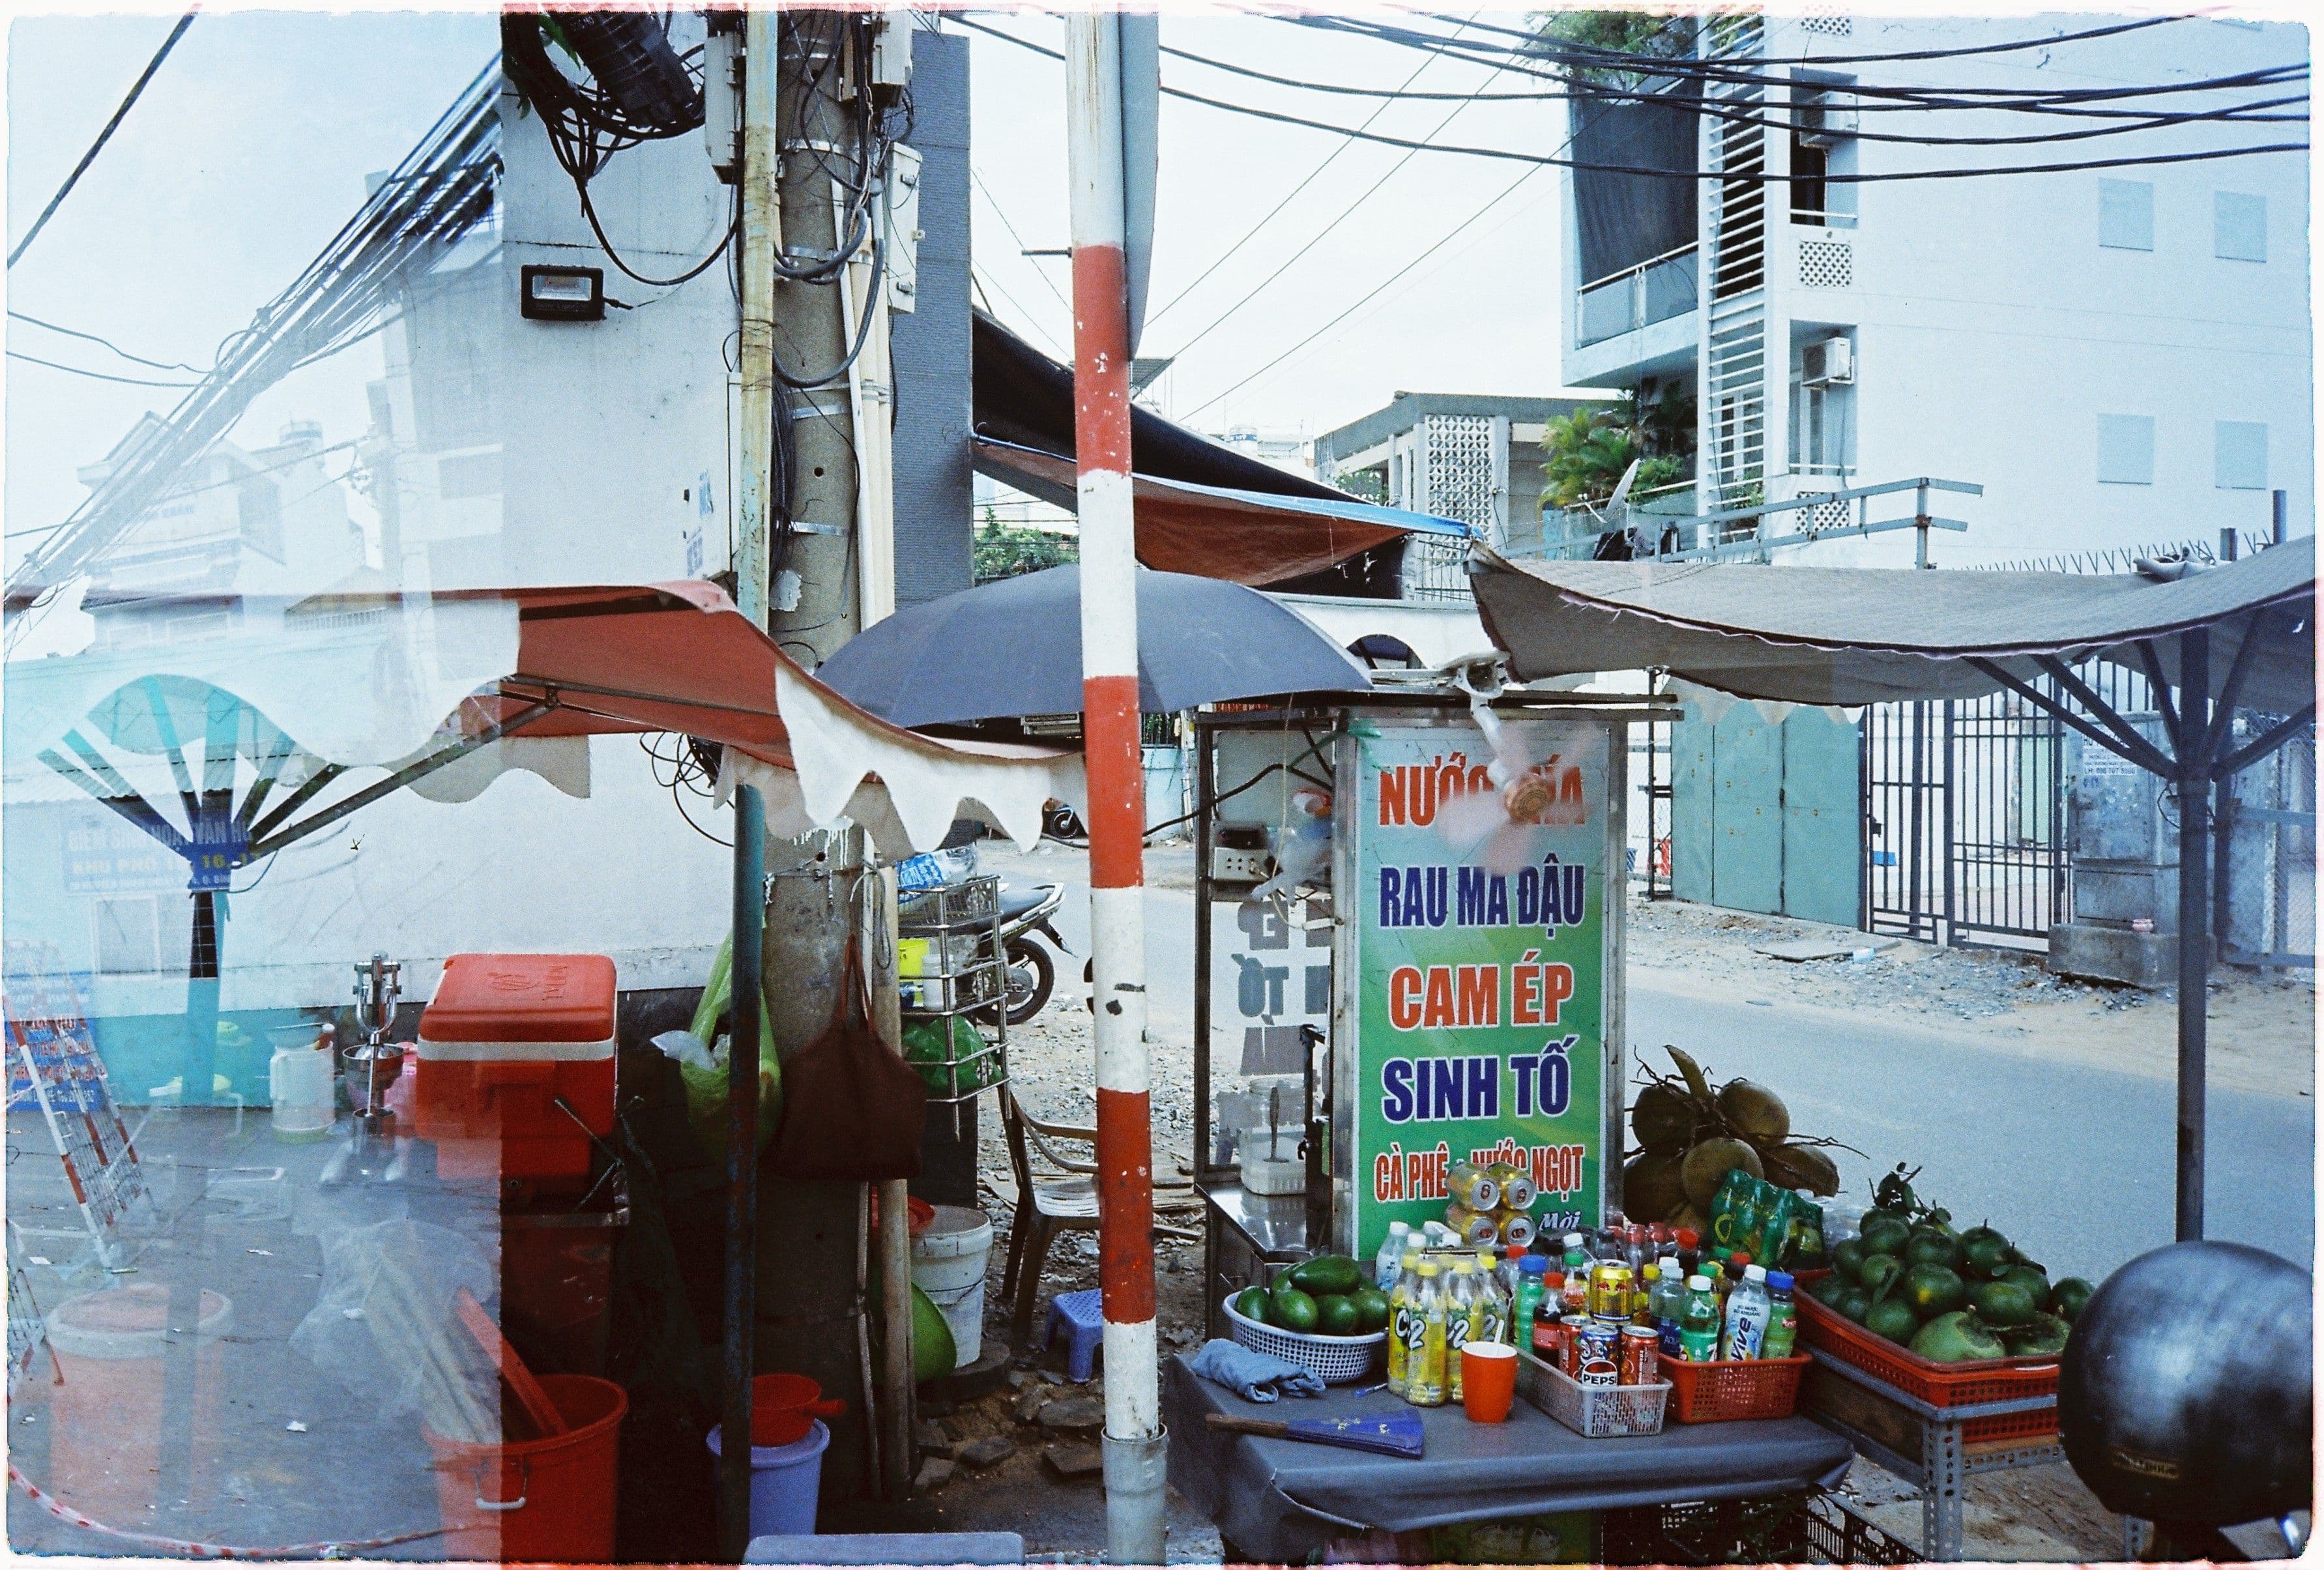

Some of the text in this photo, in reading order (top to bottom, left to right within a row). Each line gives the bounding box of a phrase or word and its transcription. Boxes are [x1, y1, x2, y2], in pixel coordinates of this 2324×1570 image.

[1380, 866, 1448, 927] RAU
[1517, 852, 1584, 937] ĐẬU
[1391, 966, 1498, 1030] CAM
[1512, 951, 1573, 1025] ÉP
[1384, 1036, 1578, 1122] SINH TỐ
[1376, 1144, 1402, 1201] CÀ
[1409, 1143, 1449, 1199] PHÊ
[1532, 1146, 1584, 1200] NGỌT
[1539, 1210, 1582, 1231] Mời
